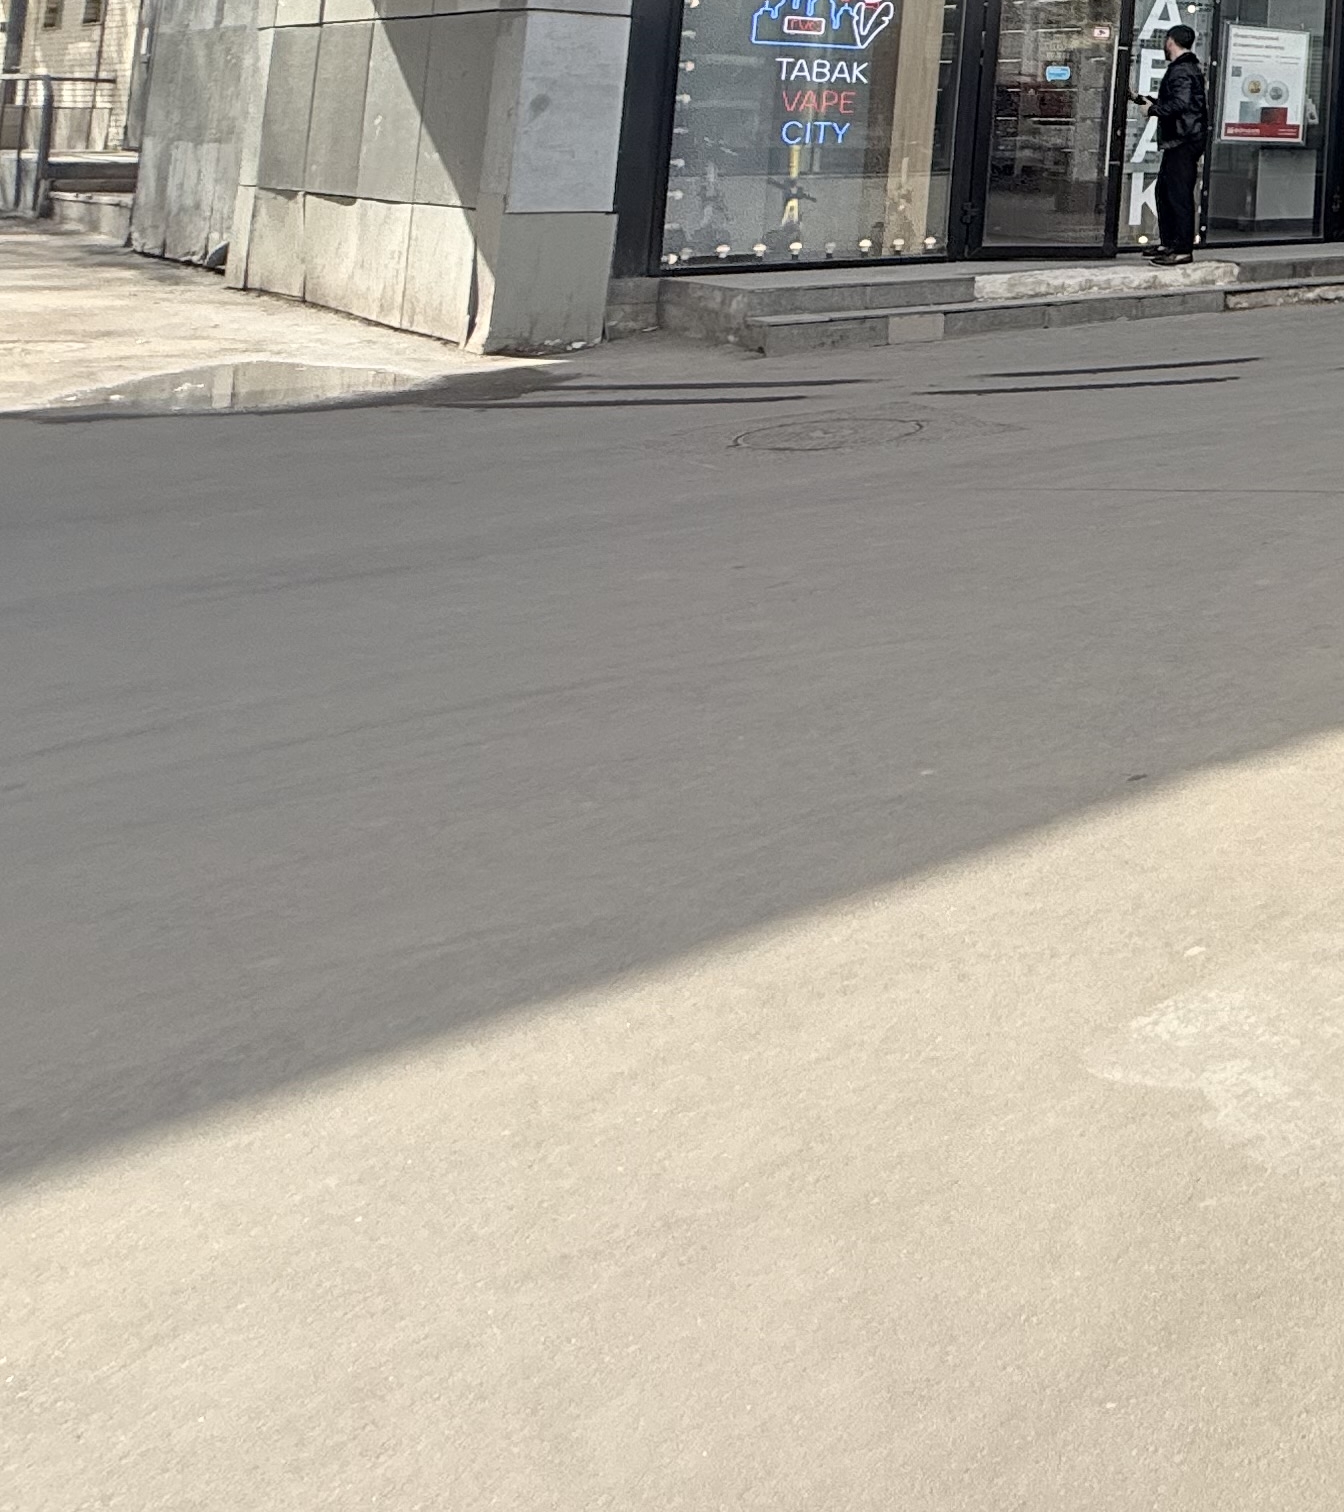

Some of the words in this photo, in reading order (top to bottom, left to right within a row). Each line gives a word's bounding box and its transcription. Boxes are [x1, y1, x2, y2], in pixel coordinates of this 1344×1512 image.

[775, 57, 869, 84] TABAK
[782, 89, 857, 115] VAPE
[781, 120, 851, 145] CITY
